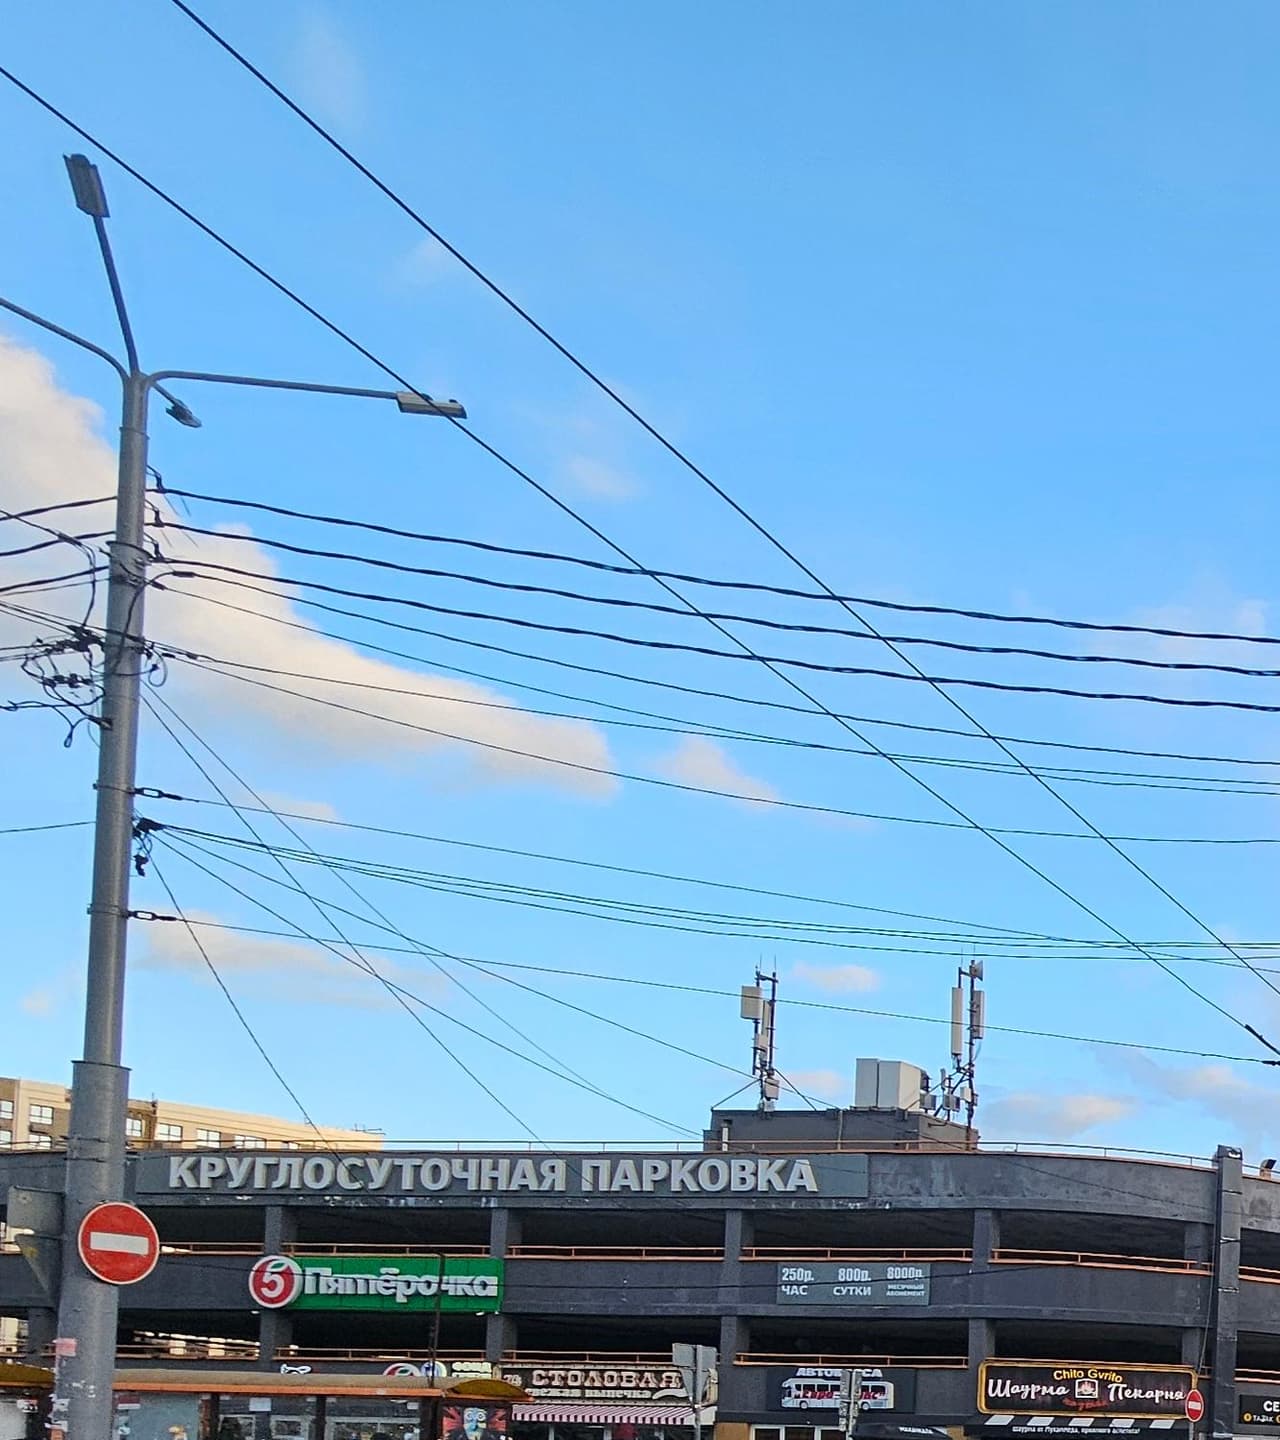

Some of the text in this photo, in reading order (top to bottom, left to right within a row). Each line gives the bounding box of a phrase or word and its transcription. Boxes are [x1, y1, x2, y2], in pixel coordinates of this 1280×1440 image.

[169, 1157, 818, 1192] КРУГЛОСУТОЧНАЯ ПАРКОВКА
[782, 1268, 814, 1282] 250р.
[838, 1268, 871, 1282] 800р.
[304, 1267, 499, 1303] Пятёрочка
[782, 1285, 808, 1296] ЧАС
[833, 1286, 871, 1296] СУТКИ
[532, 1370, 682, 1388] СТОЛОВАЯ
[1053, 1369, 1084, 1381] Chito
[988, 1379, 1187, 1403] Шаурма Пекарня
